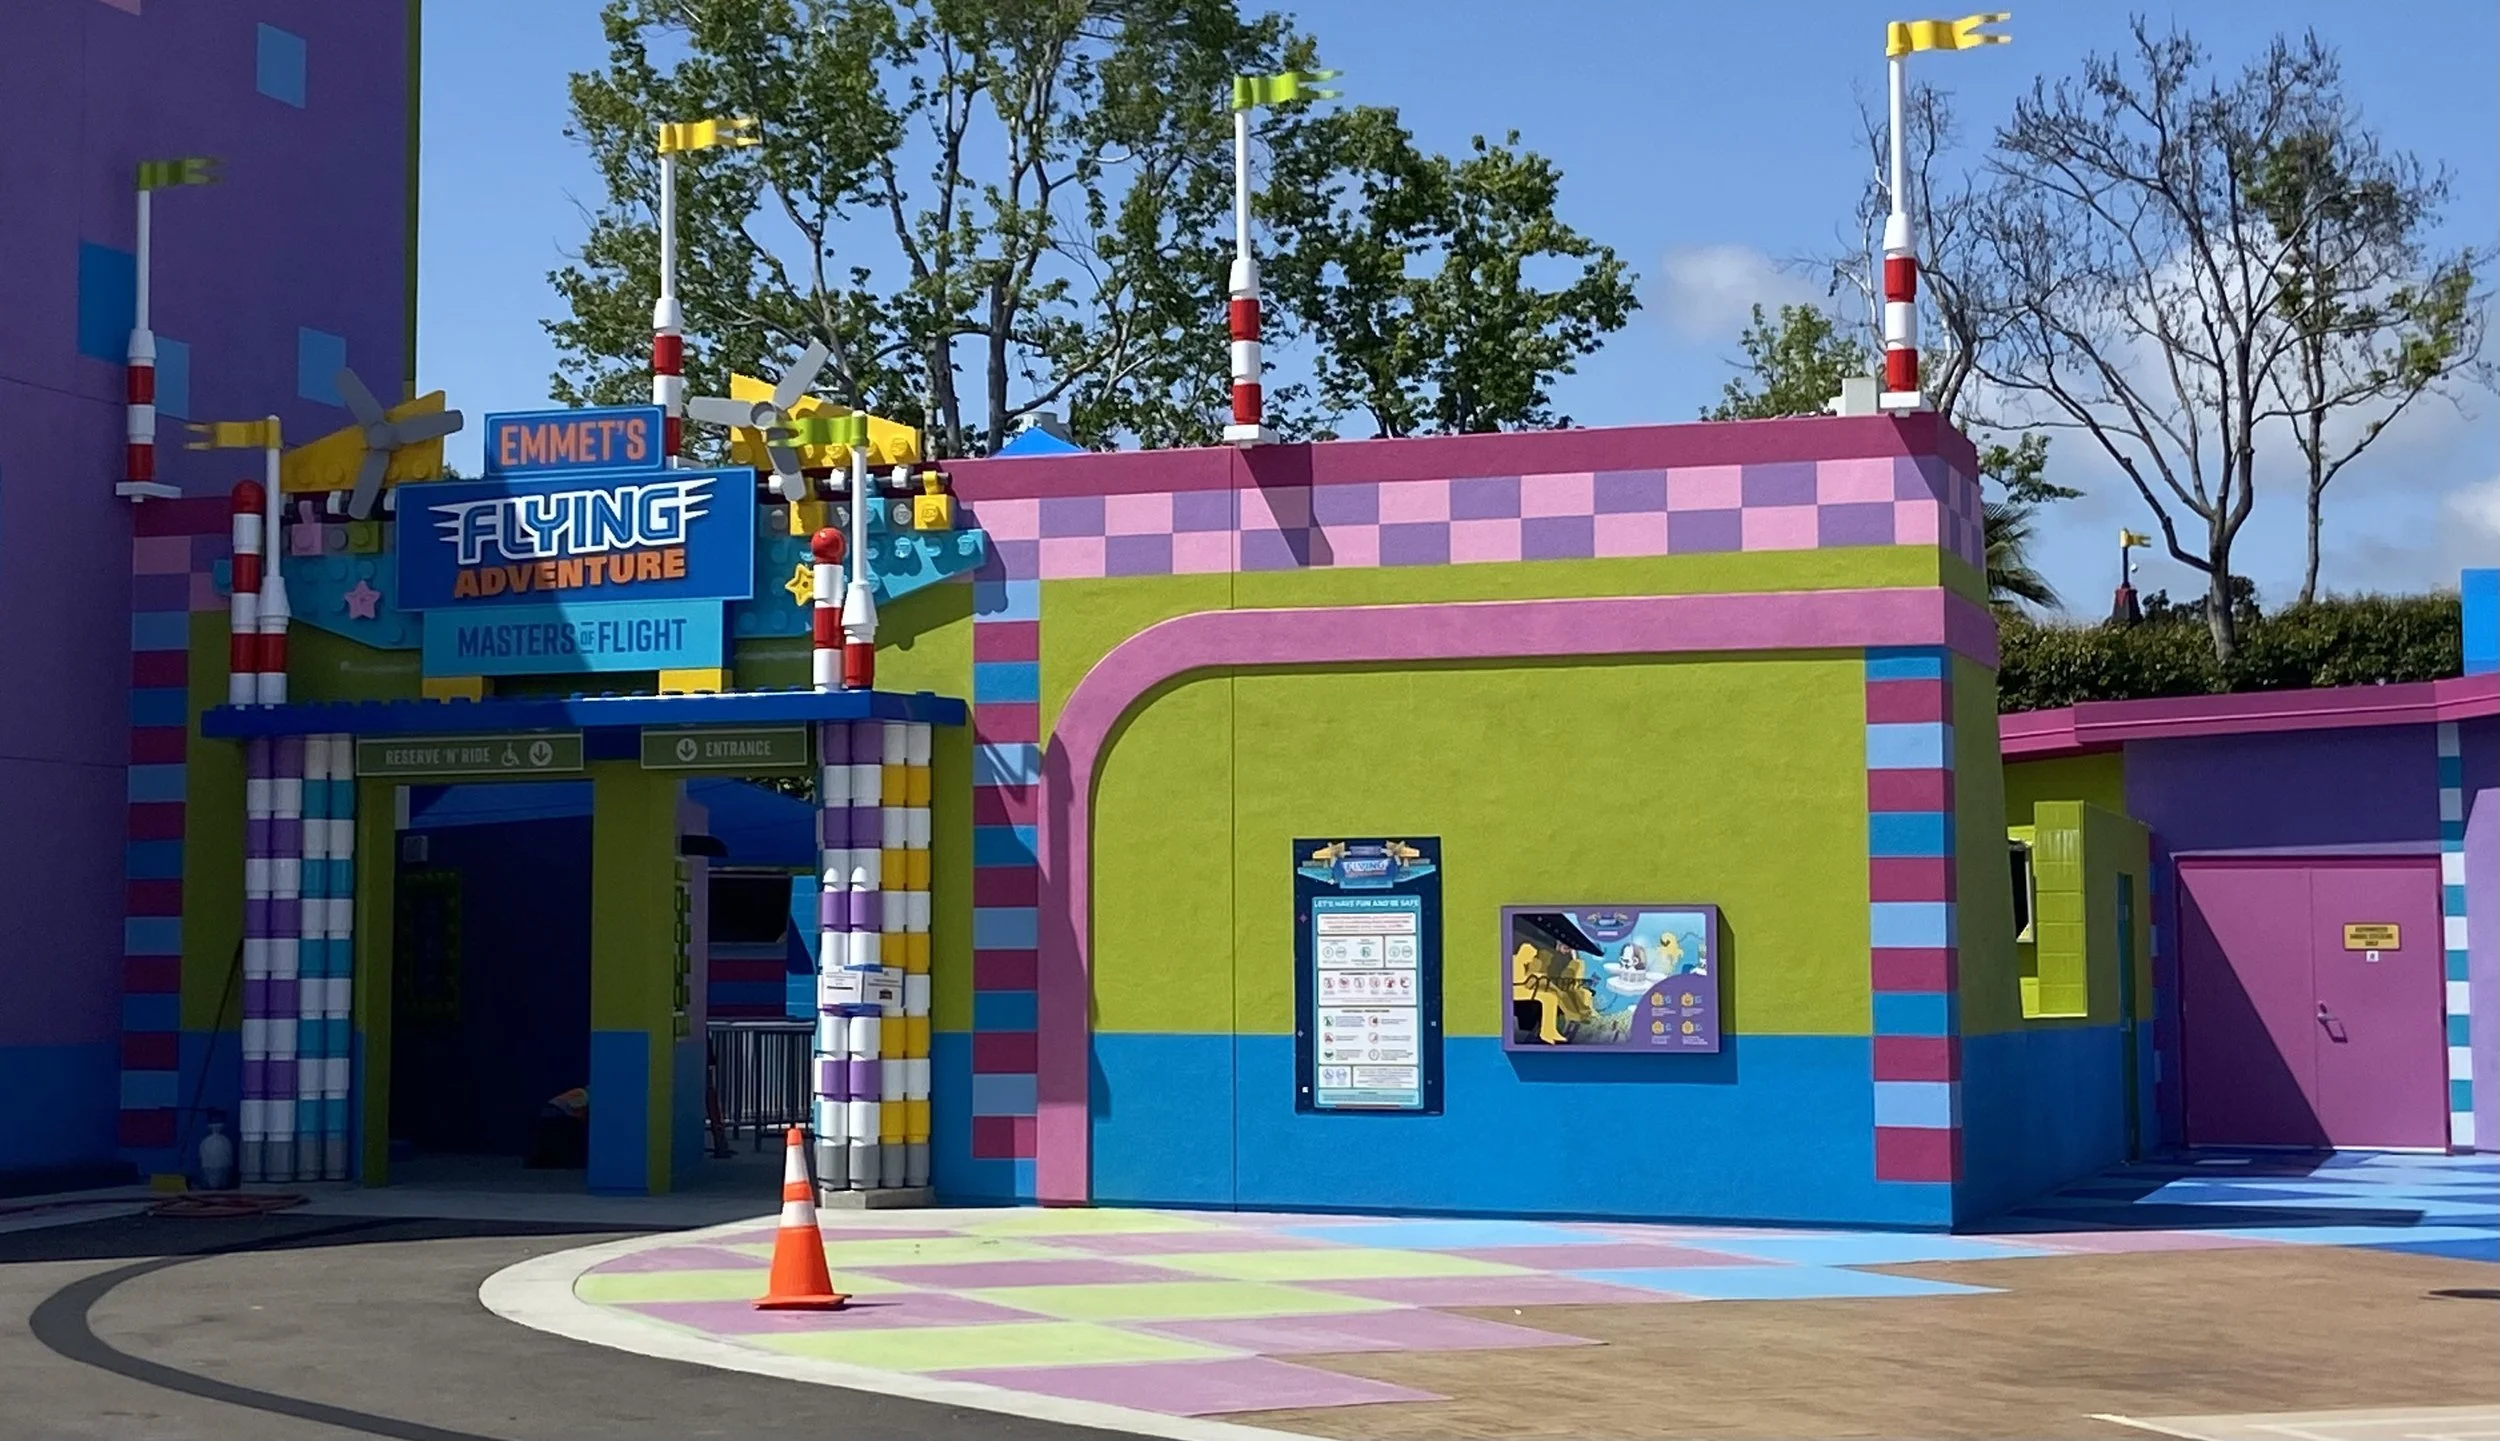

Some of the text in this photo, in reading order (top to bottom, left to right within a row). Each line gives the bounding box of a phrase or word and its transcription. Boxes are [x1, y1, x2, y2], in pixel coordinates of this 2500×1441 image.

[501, 417, 647, 467] EMMET'S
[447, 478, 694, 565] FLYING
[453, 548, 686, 599] ADVENTURE
[457, 619, 687, 658] MASTERS OF FLIGHT
[386, 749, 440, 765] RESERVE
[461, 746, 491, 763] RIDE
[706, 740, 772, 757] ENTRANCE
